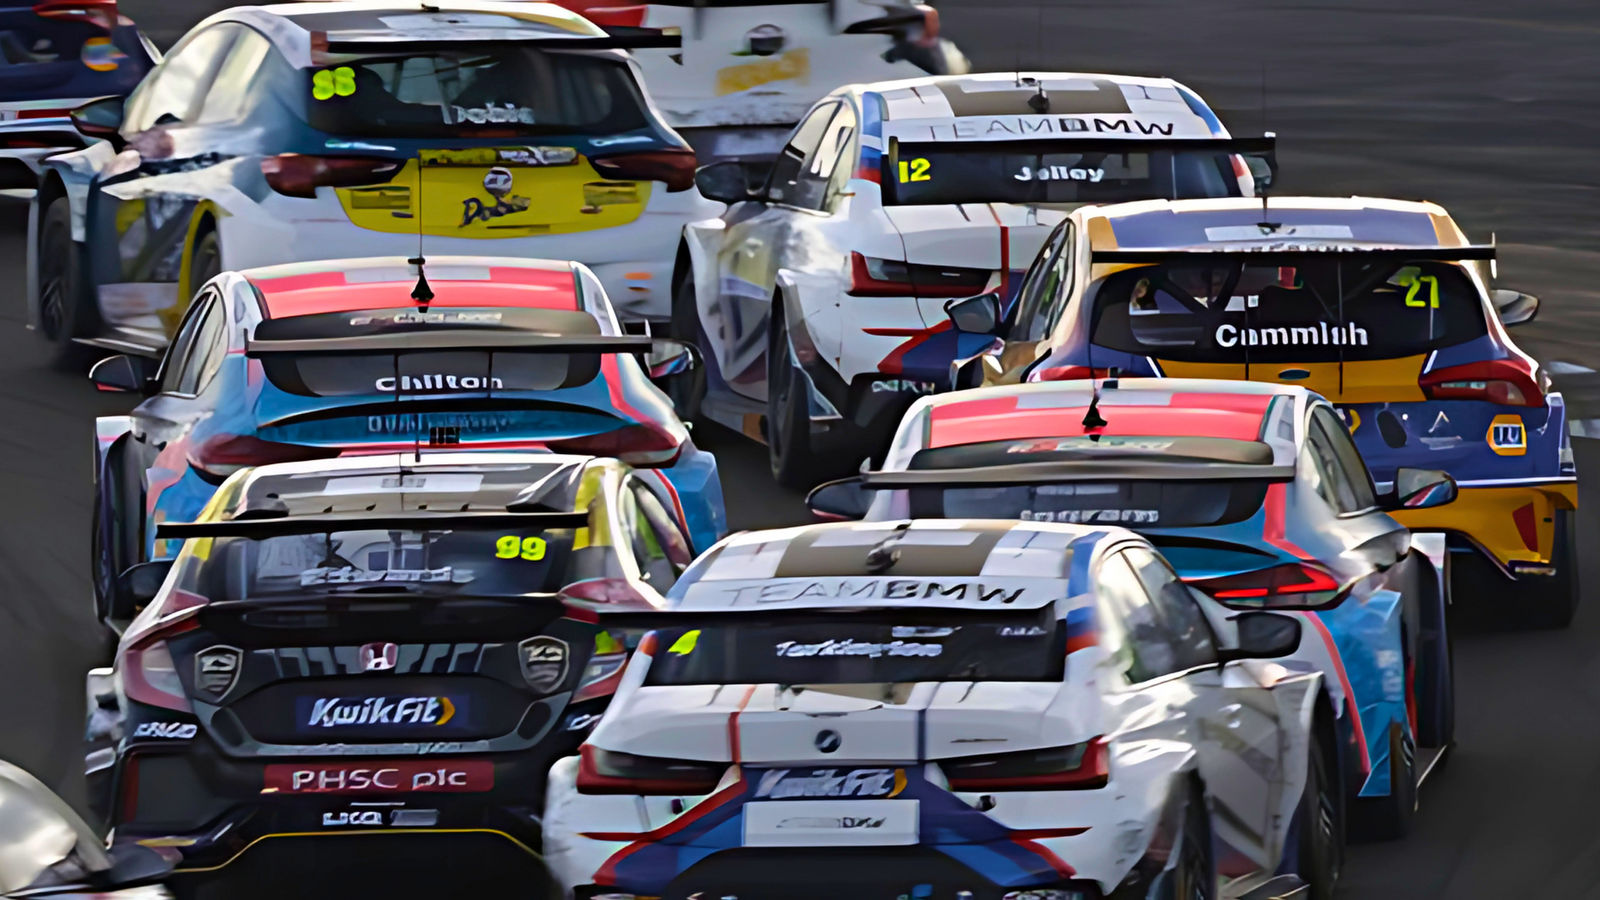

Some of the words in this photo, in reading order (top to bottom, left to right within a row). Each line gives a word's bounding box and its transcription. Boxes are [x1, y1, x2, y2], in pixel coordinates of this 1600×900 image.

[898, 158, 931, 183] 12
[495, 535, 547, 561] 99
[292, 768, 399, 790] PHSC
[411, 768, 467, 790] plc
